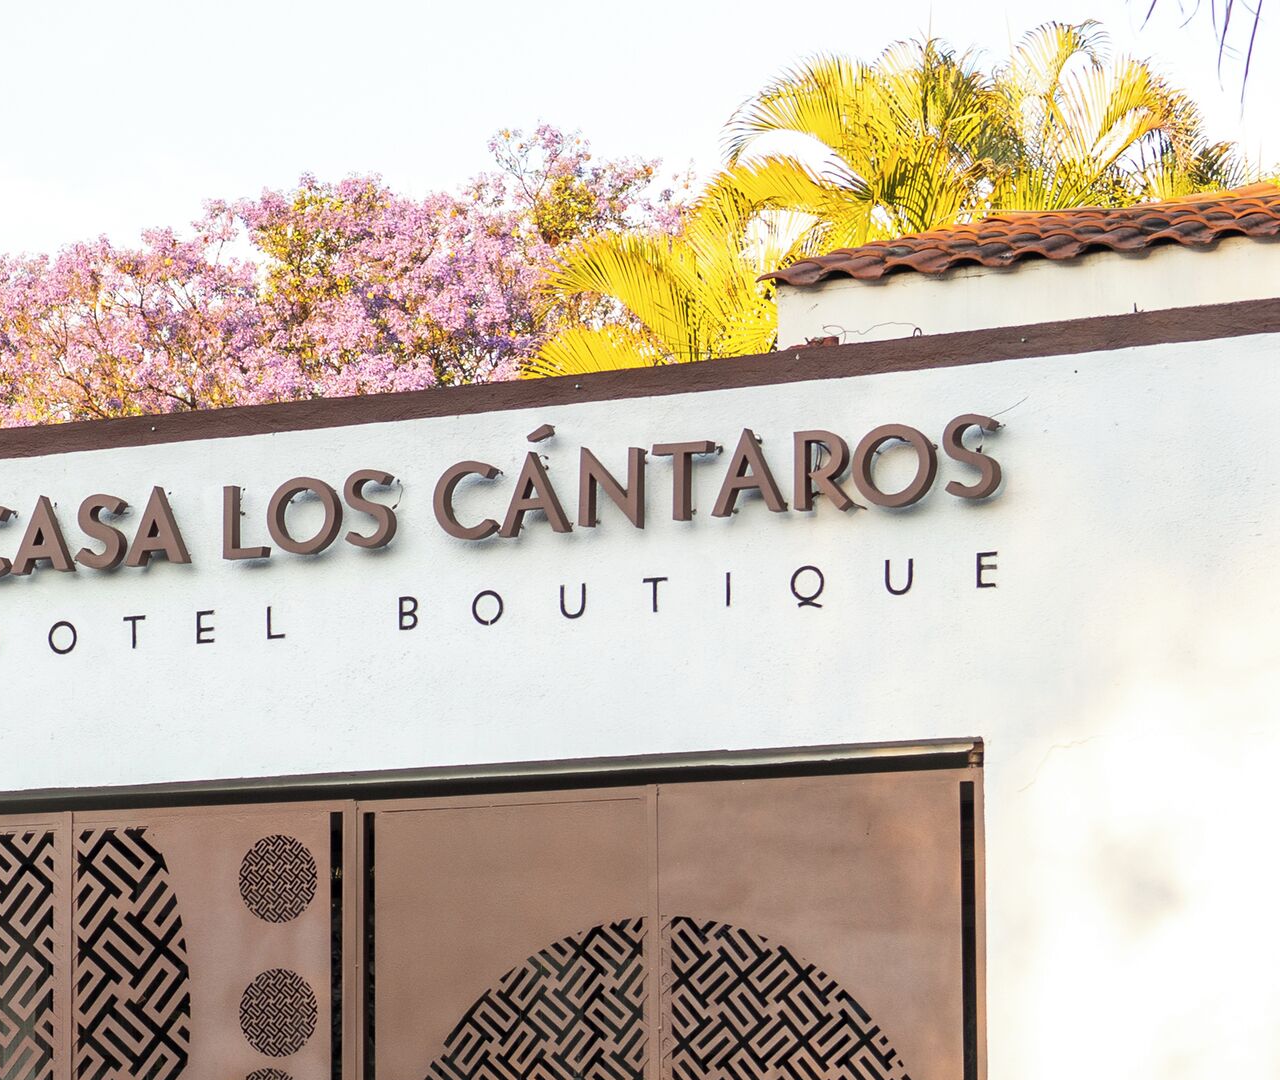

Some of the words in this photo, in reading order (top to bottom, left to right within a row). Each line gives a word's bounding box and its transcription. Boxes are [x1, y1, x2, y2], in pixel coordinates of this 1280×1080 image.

[222, 468, 398, 562] LOS
[432, 413, 1002, 541] CÁNTAROS
[398, 551, 999, 631] BOUTIQUE
